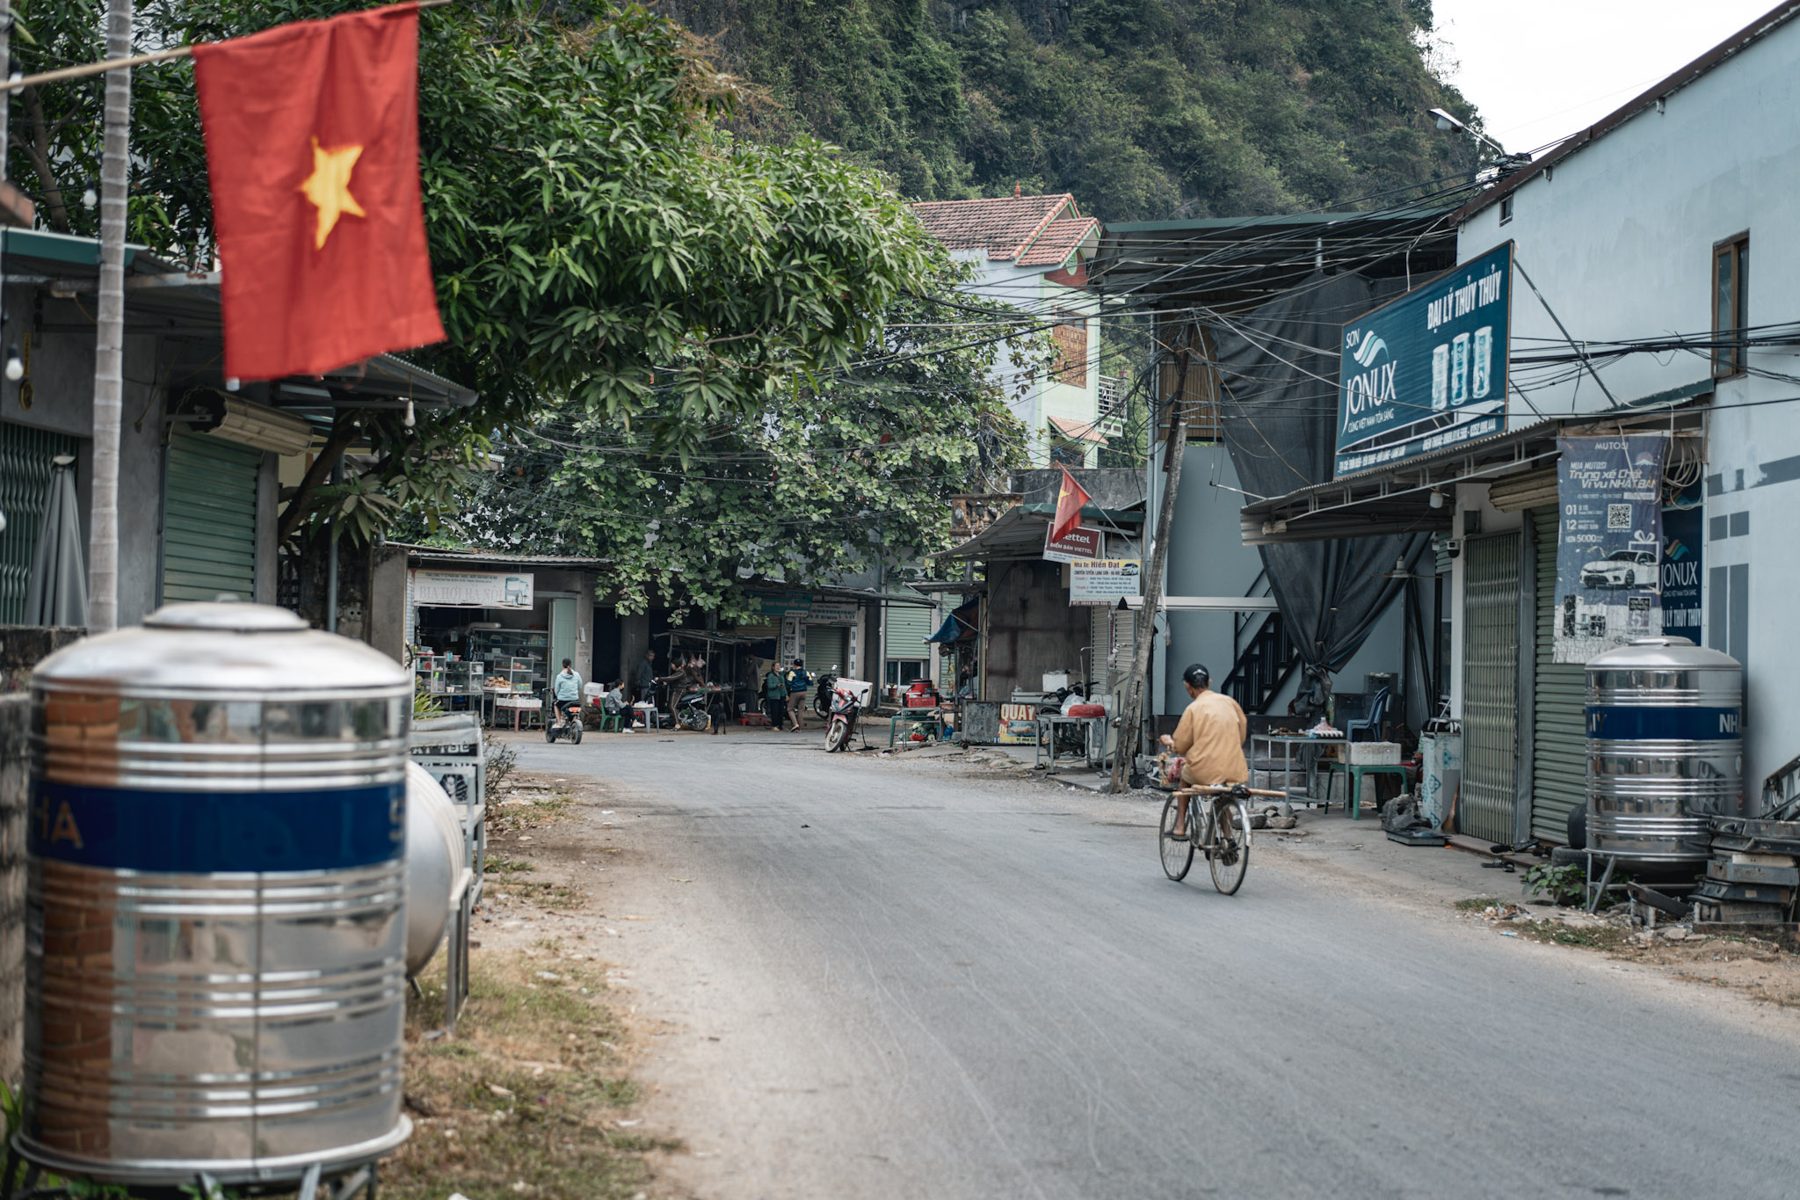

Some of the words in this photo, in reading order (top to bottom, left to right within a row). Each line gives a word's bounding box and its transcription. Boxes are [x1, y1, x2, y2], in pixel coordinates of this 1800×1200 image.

[1427, 300, 1442, 333] ĐẠI
[1443, 287, 1454, 324] LÝ
[1455, 275, 1477, 318] THỦY
[1478, 264, 1502, 307] THỦY
[1341, 360, 1397, 437] JONUX
[1565, 504, 1577, 516] 01
[1566, 519, 1577, 530] 12
[1001, 703, 1035, 720] QUAY
